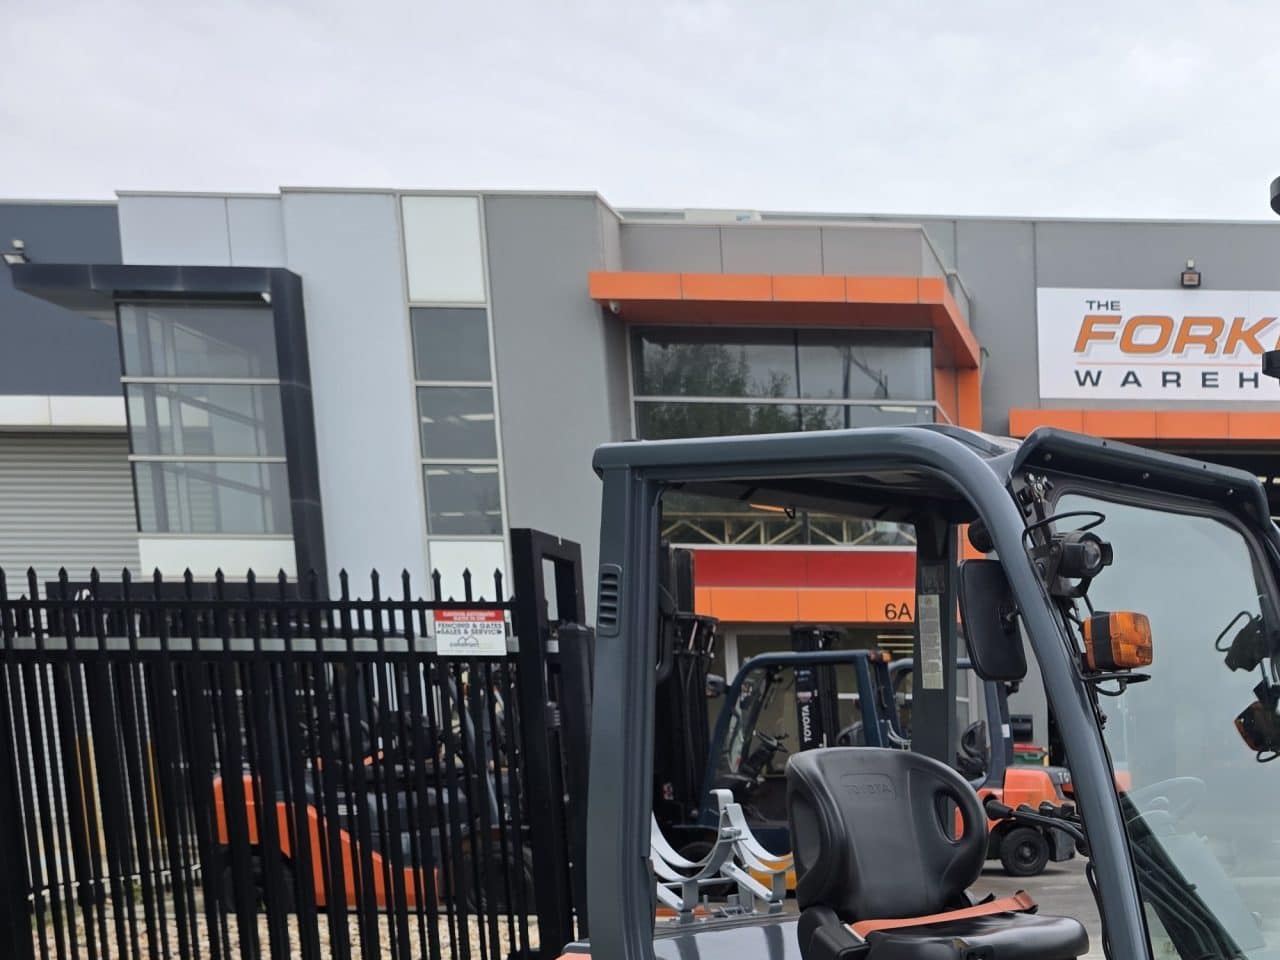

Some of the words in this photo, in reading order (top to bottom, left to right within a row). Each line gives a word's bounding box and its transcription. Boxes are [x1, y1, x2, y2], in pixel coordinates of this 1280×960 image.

[1085, 300, 1121, 311] THE
[884, 602, 913, 620] 6A
[801, 704, 812, 743] TOYOTA
